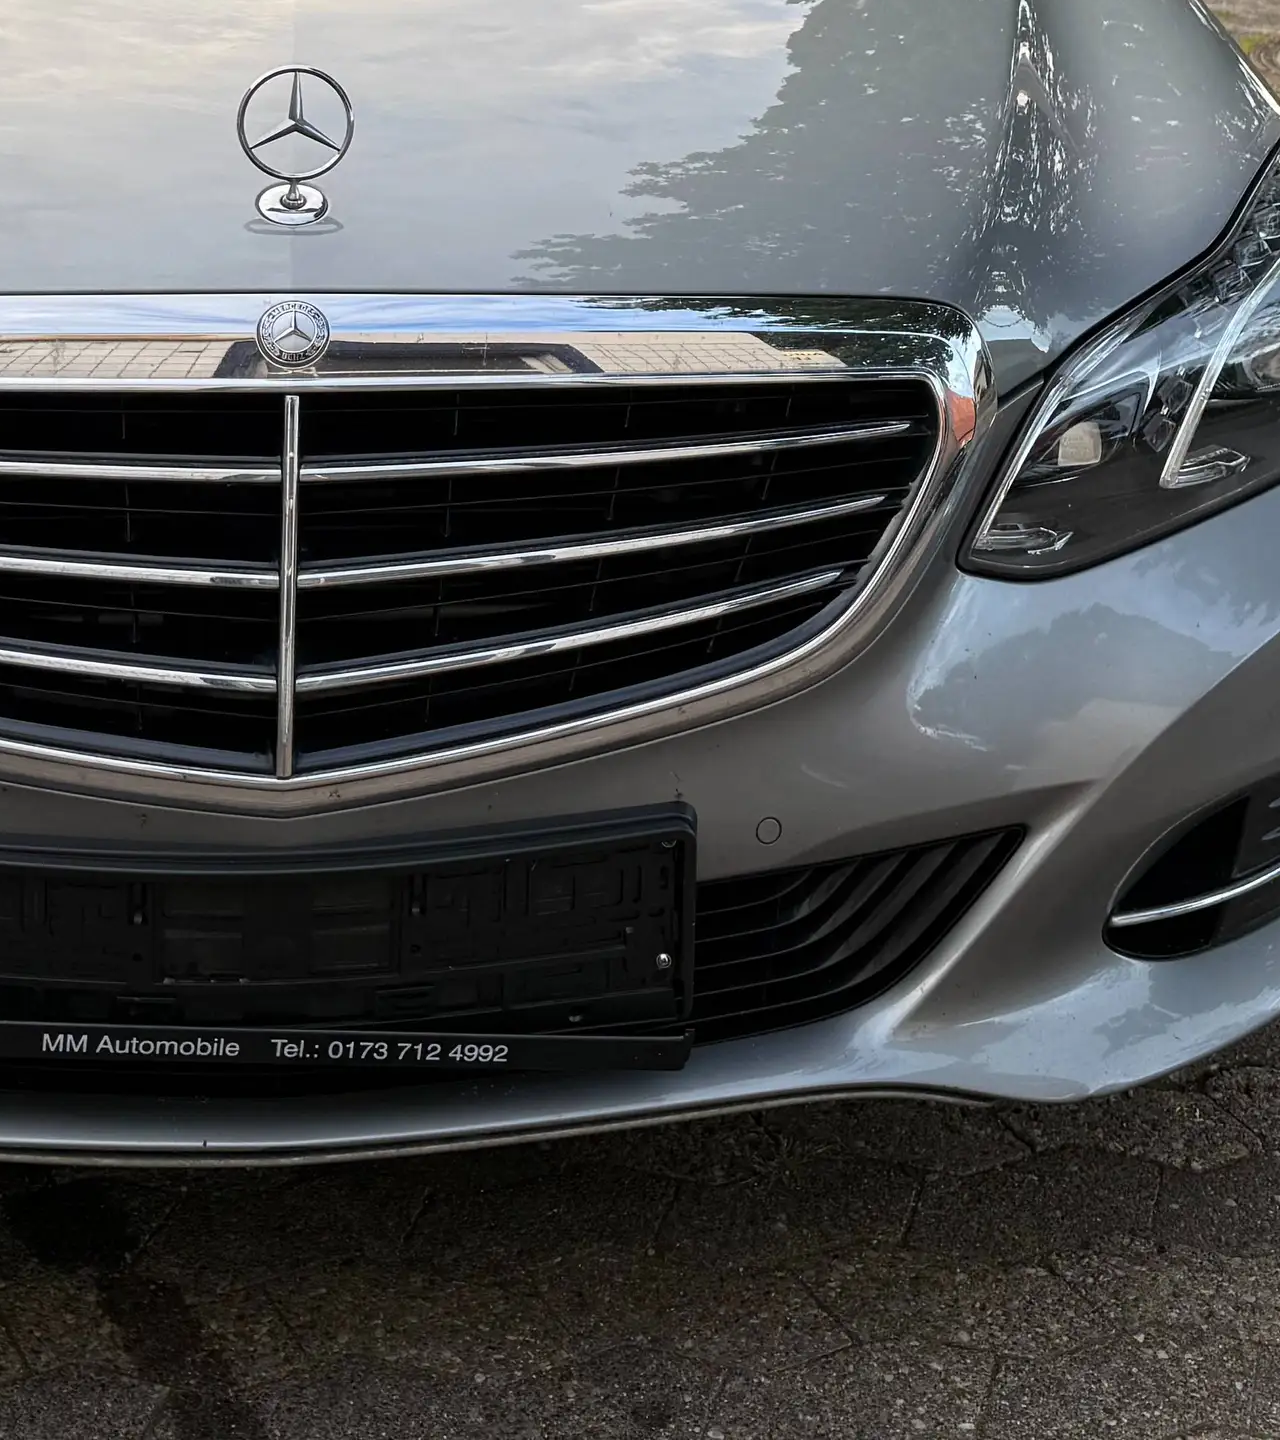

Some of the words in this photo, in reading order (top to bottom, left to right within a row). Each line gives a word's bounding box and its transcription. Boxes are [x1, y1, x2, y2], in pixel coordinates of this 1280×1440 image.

[41, 1033, 89, 1053] MM
[95, 1035, 241, 1057] Automobile
[270, 1039, 320, 1058] Tel.:
[327, 1040, 389, 1060] 0173
[397, 1042, 442, 1061] 712
[448, 1044, 510, 1062] 4992
